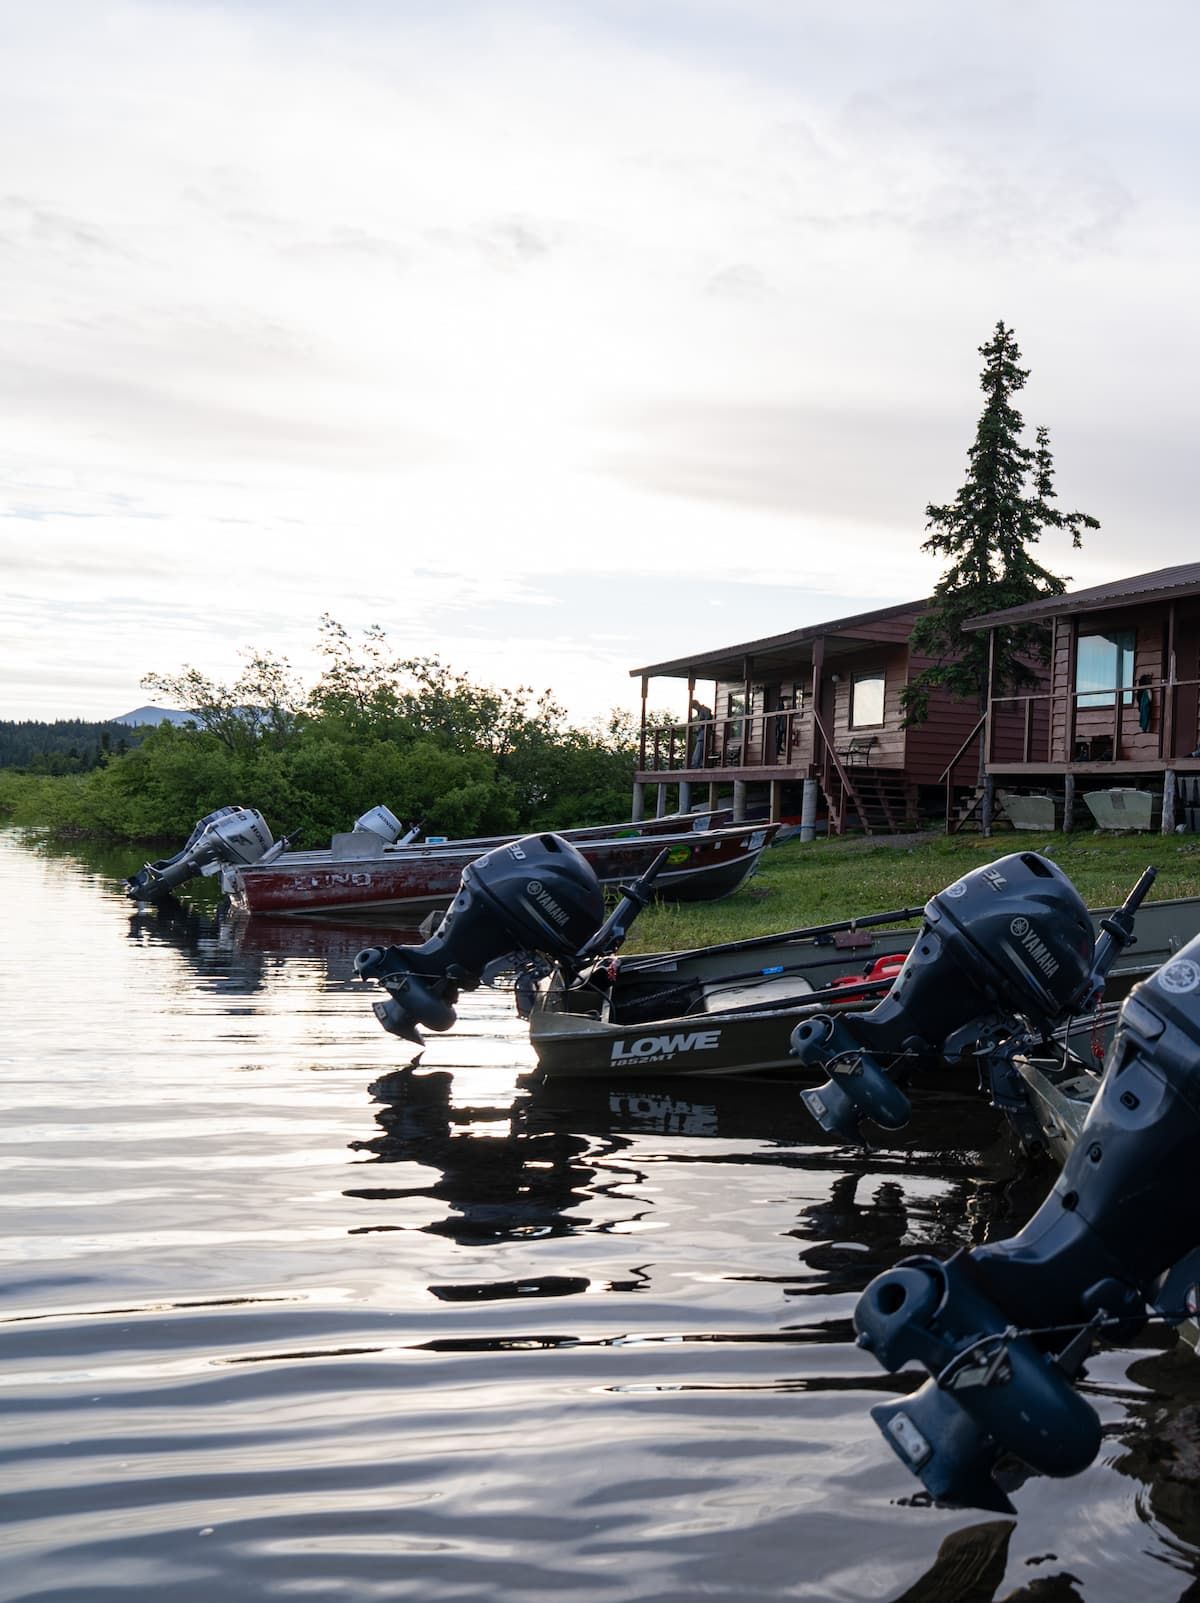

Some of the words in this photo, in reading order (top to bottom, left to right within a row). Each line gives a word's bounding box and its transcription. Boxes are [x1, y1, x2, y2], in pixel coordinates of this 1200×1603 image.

[535, 889, 571, 927] YAMAHA
[1021, 929, 1060, 979] YAMAHA
[610, 1029, 722, 1060] LOWE
